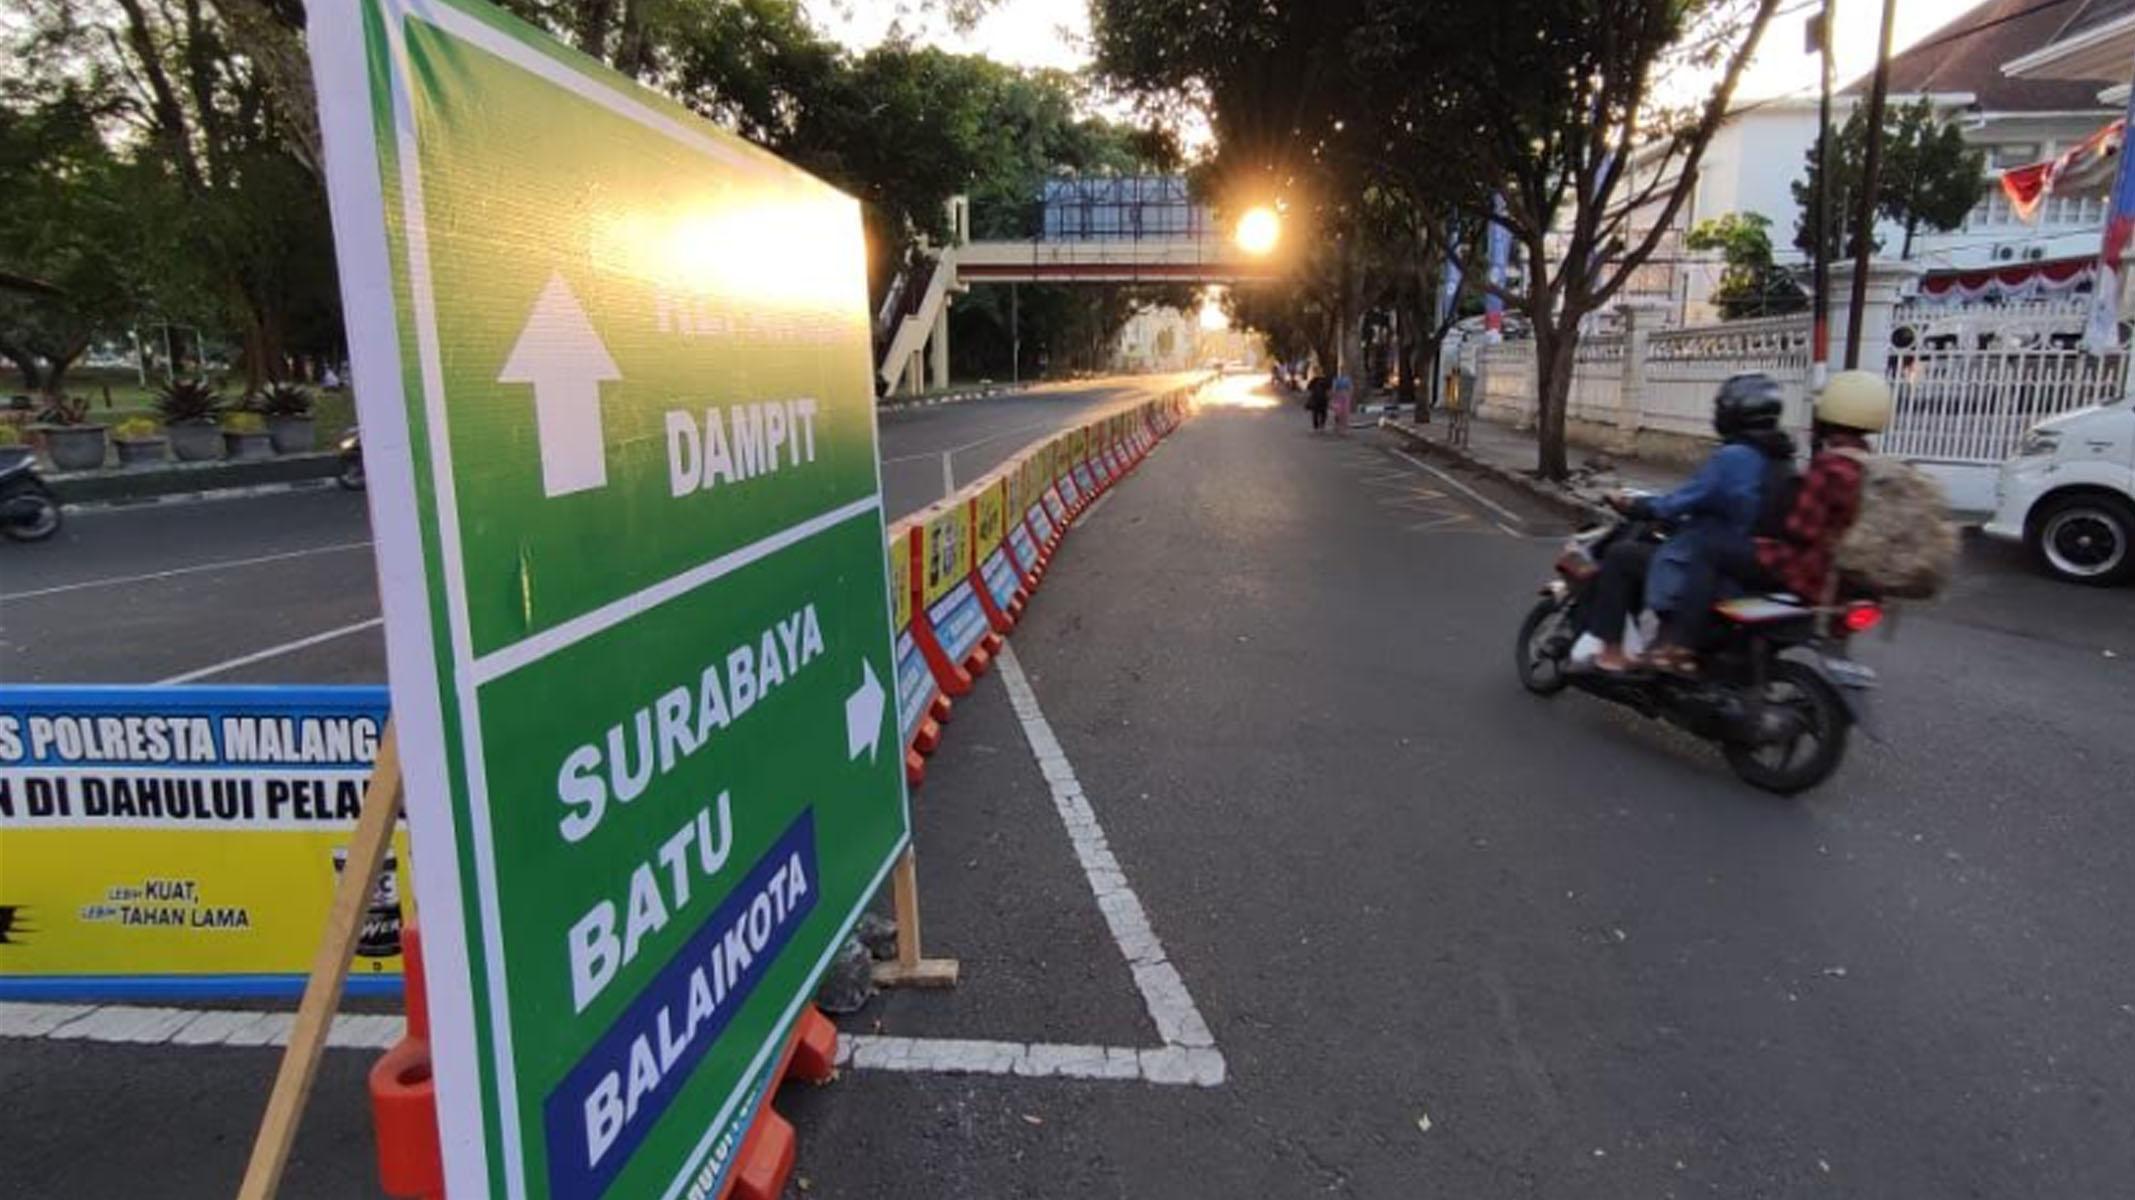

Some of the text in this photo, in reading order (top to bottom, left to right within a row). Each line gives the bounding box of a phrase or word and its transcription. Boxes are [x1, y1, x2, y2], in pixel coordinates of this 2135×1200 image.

[664, 397, 817, 498] DAMPIT
[30, 716, 216, 761] POLRESTA
[223, 717, 378, 763] MALANG
[557, 603, 825, 843] SURABAYA
[25, 777, 72, 817] DI
[81, 778, 254, 820] DAHULUI
[266, 779, 372, 820] PELA
[120, 906, 185, 926] TAHAN
[191, 909, 250, 928] LAMA
[145, 880, 199, 905] KUAT,
[567, 790, 734, 1016] BATU
[583, 851, 808, 1169] BALAIKOTA
